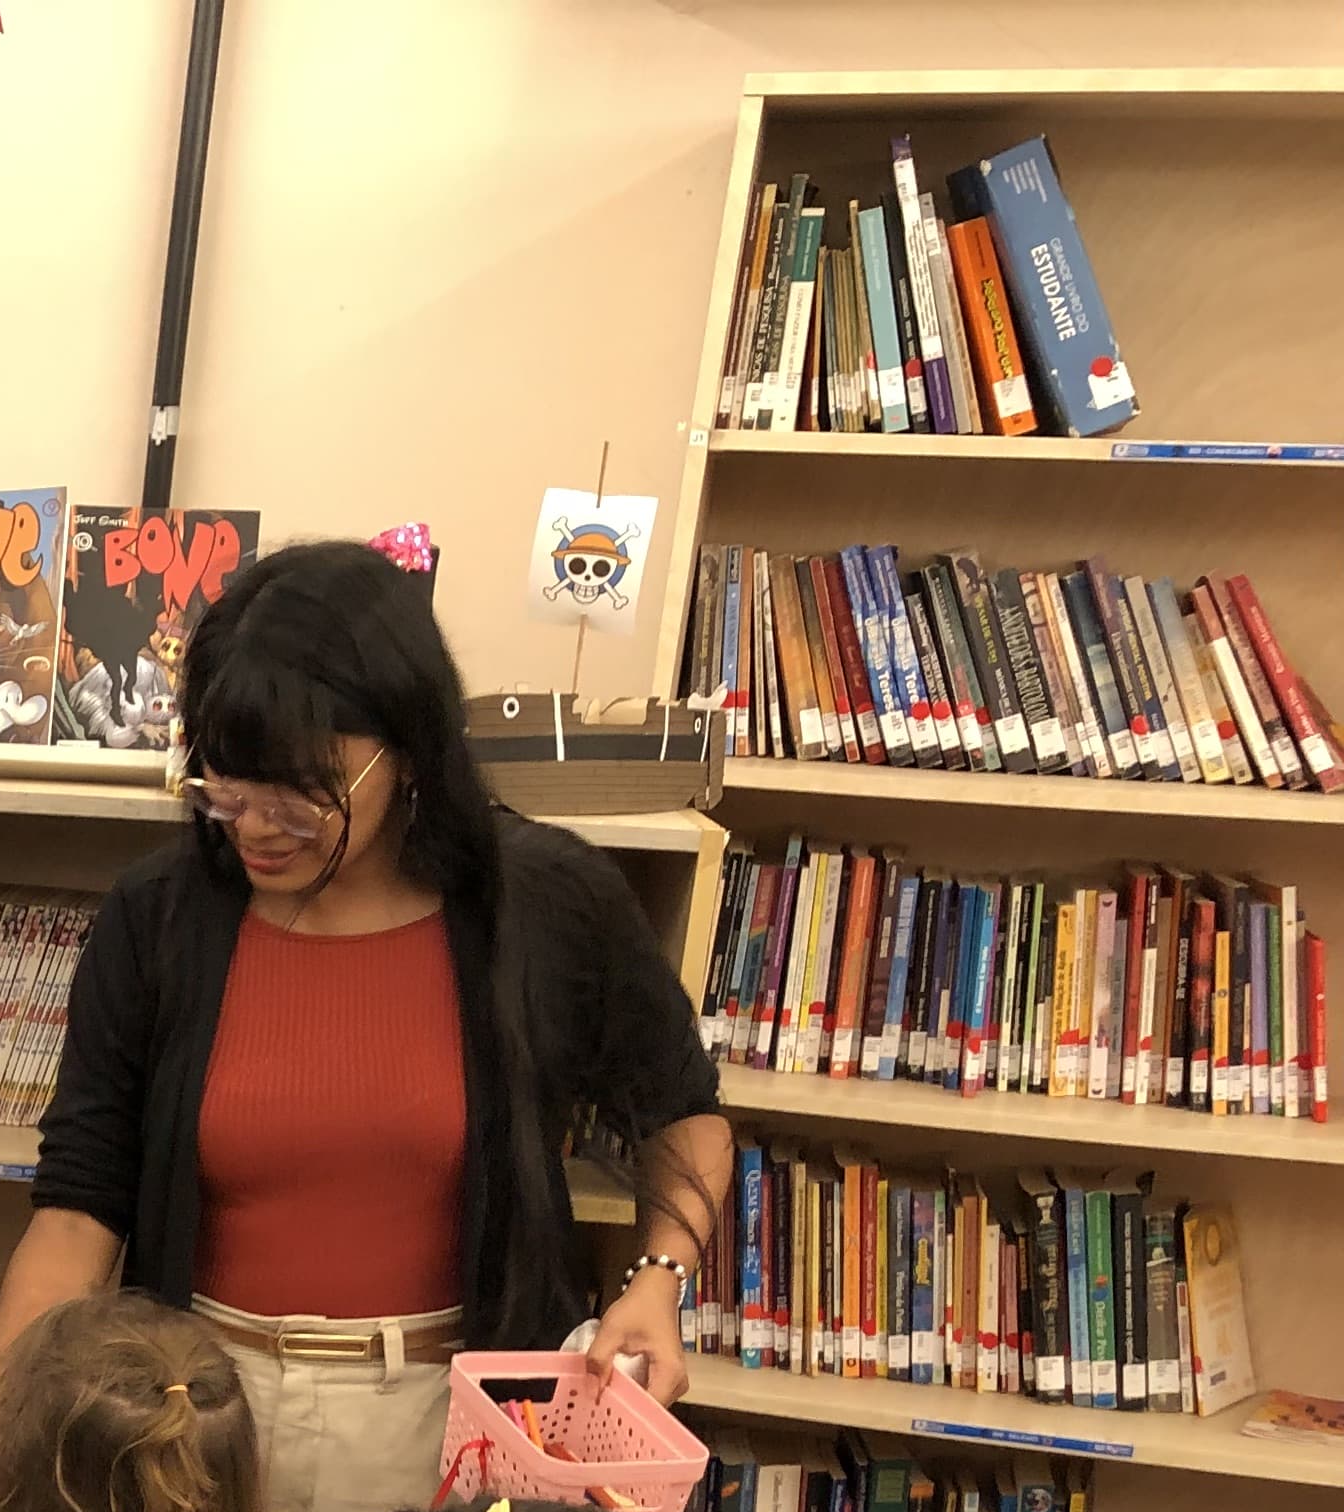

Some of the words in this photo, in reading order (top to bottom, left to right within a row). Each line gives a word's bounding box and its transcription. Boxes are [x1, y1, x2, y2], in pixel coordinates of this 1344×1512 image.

[757, 284, 776, 333] PESQUISA
[1029, 242, 1076, 342] ESTUDANTE
[1048, 236, 1073, 282] GRANDE
[1063, 282, 1082, 313] LIVRO
[1074, 312, 1090, 333] DO
[75, 535, 90, 549] 10
[104, 515, 242, 612] BONE
[875, 671, 898, 713] Teres
[1013, 666, 1052, 726] BARTOLOM
